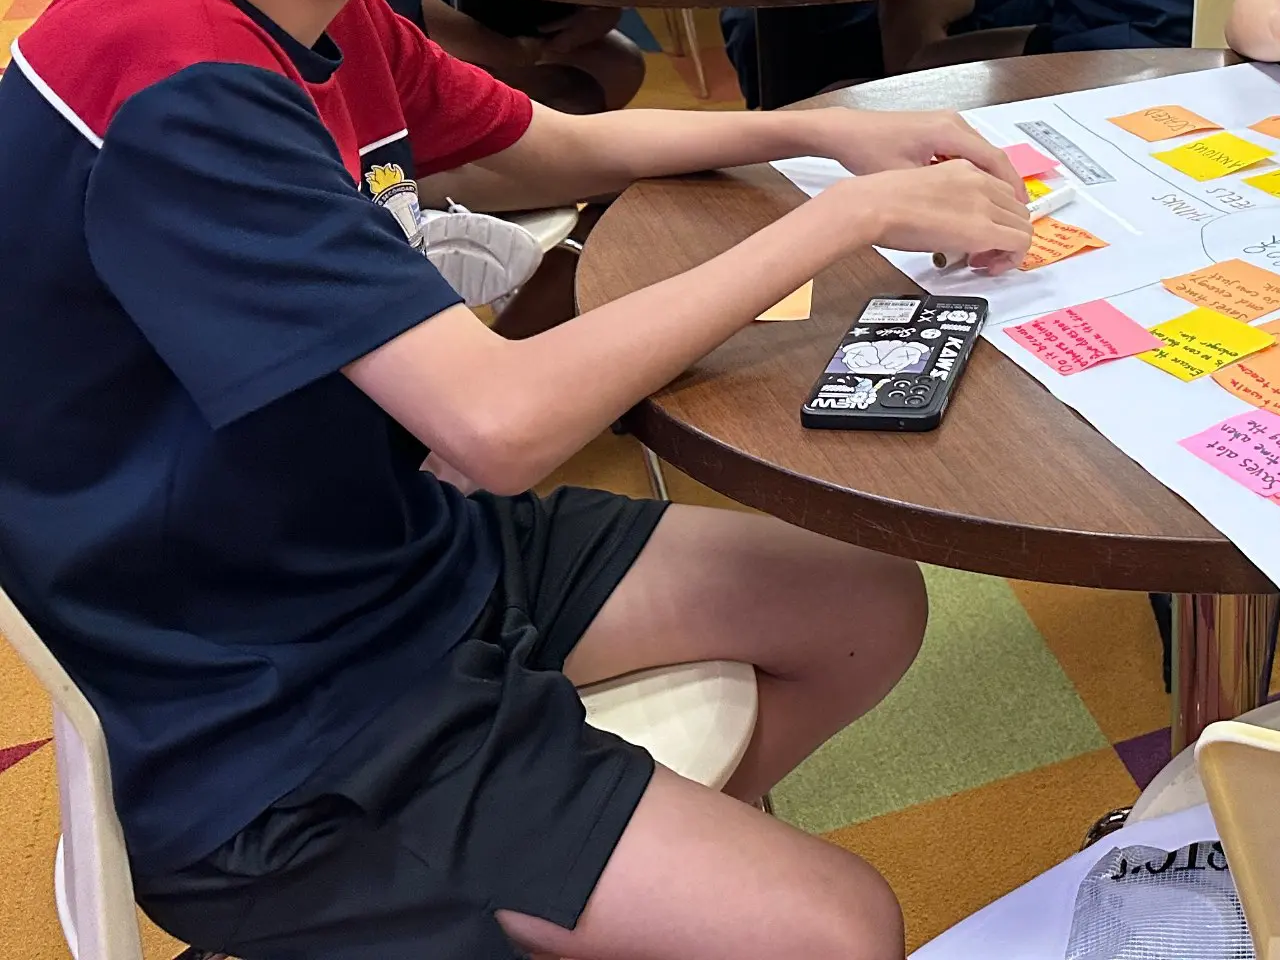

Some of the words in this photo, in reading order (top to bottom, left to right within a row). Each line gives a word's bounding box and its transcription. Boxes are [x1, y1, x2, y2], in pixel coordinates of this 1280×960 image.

[1187, 142, 1245, 169] ANXIOUS
[1152, 194, 1216, 223] THINKS
[1205, 188, 1256, 210] FEELS
[1209, 301, 1248, 320] Saves
[1234, 298, 1264, 311] and
[1014, 325, 1047, 352] because
[1067, 330, 1088, 347] does
[930, 336, 963, 381] KAWS
[1055, 342, 1088, 367] others
[1057, 360, 1073, 372] Do
[1247, 420, 1268, 434] the
[1206, 441, 1239, 458] alot
[1253, 443, 1280, 465] time
